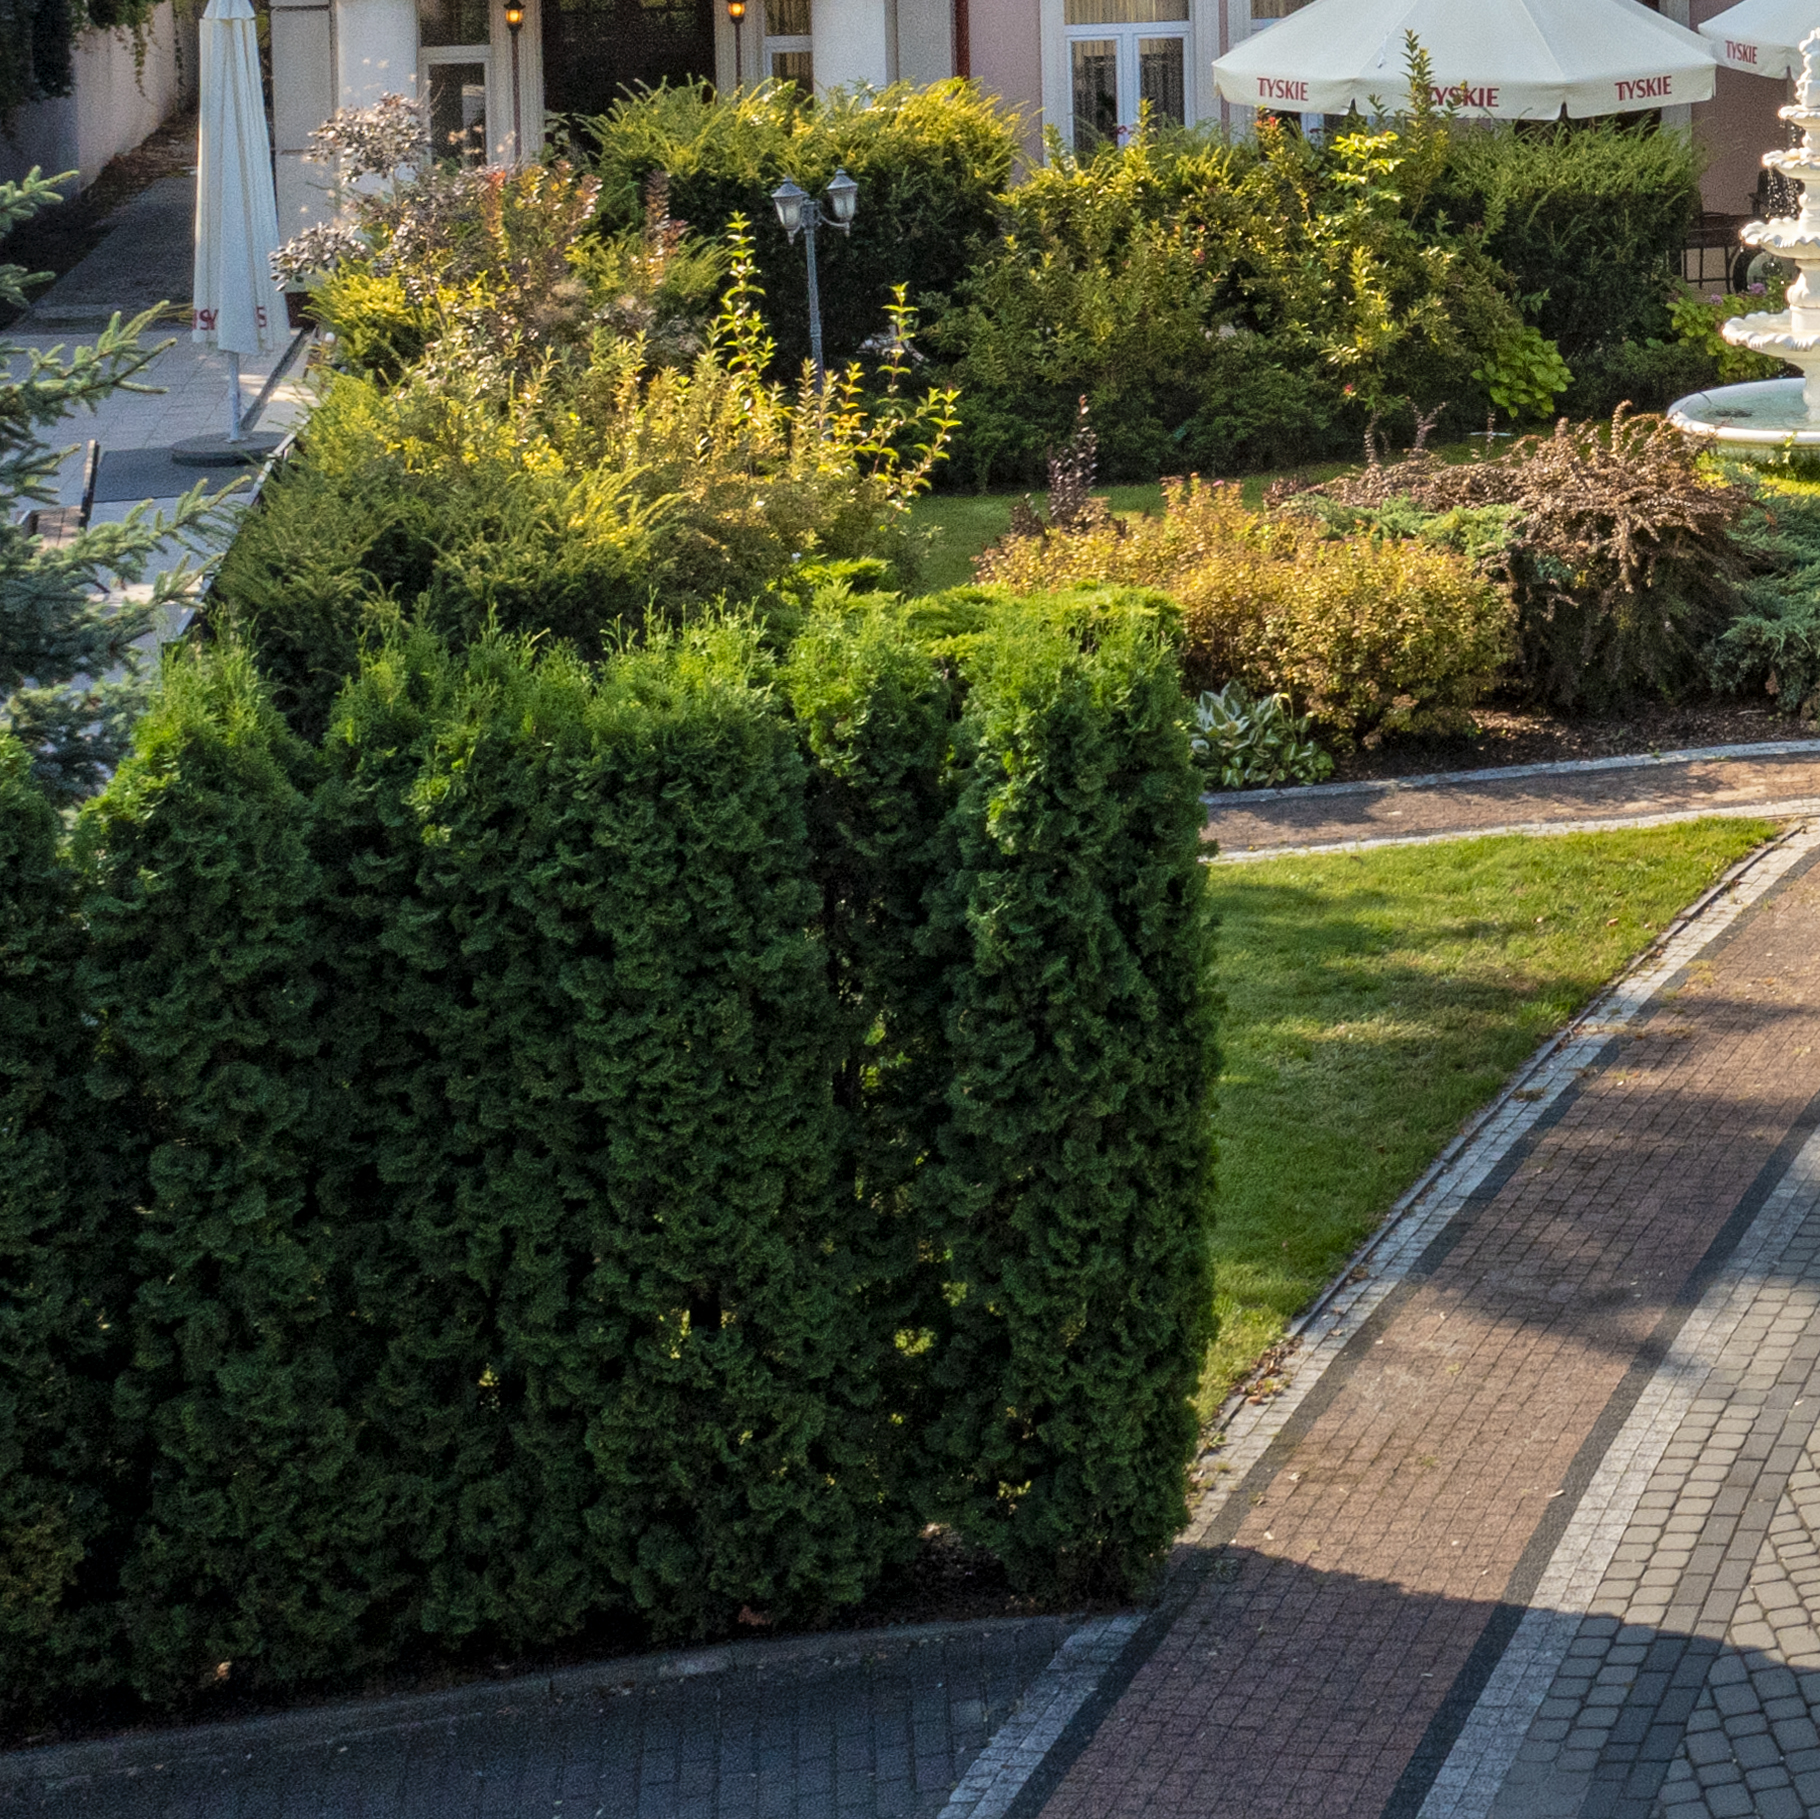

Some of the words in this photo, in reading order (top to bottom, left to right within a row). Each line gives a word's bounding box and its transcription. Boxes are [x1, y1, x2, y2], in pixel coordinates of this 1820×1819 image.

[1725, 40, 1757, 64] TYSKIE
[1257, 77, 1309, 101] TYSKIE
[1614, 75, 1672, 101] TYSKIE
